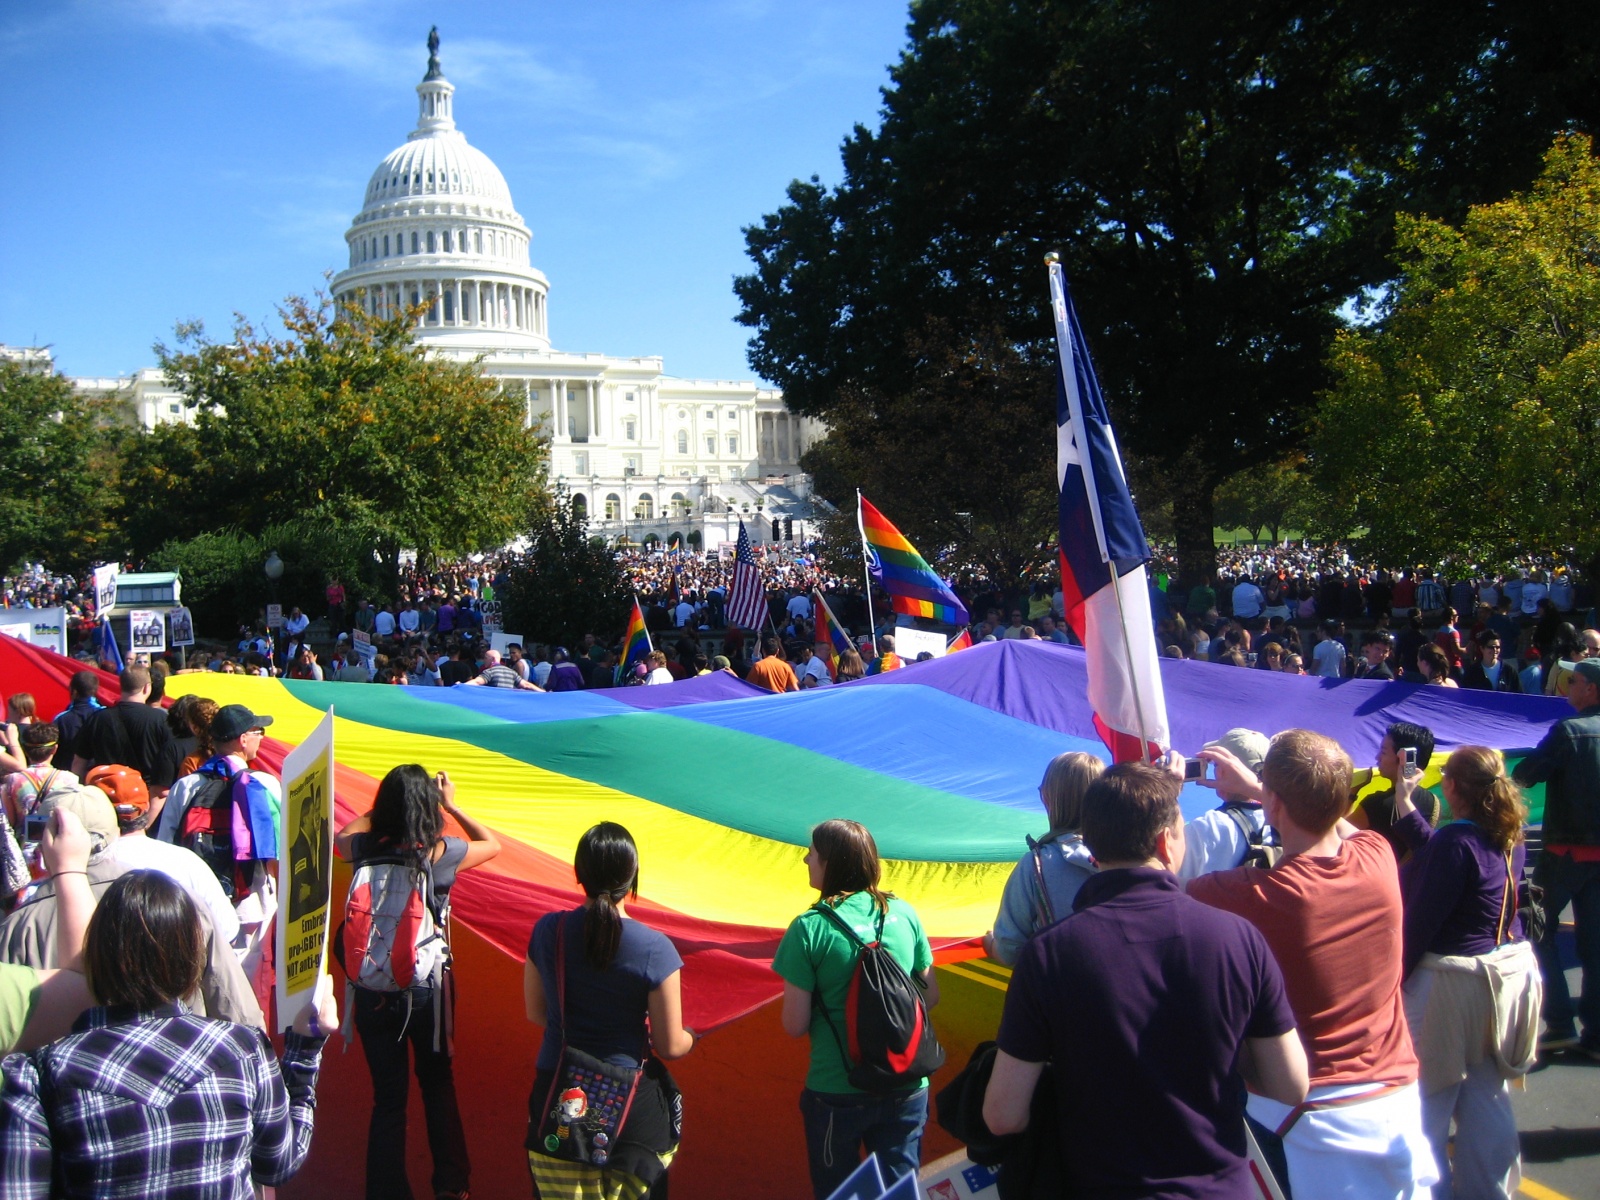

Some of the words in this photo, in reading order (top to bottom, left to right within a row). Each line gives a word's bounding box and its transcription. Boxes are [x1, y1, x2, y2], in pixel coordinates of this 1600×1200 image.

[35, 622, 61, 635] the
[302, 911, 327, 933] Embrac
[289, 933, 317, 960] pro-LGBT
[287, 961, 299, 978] NOT
